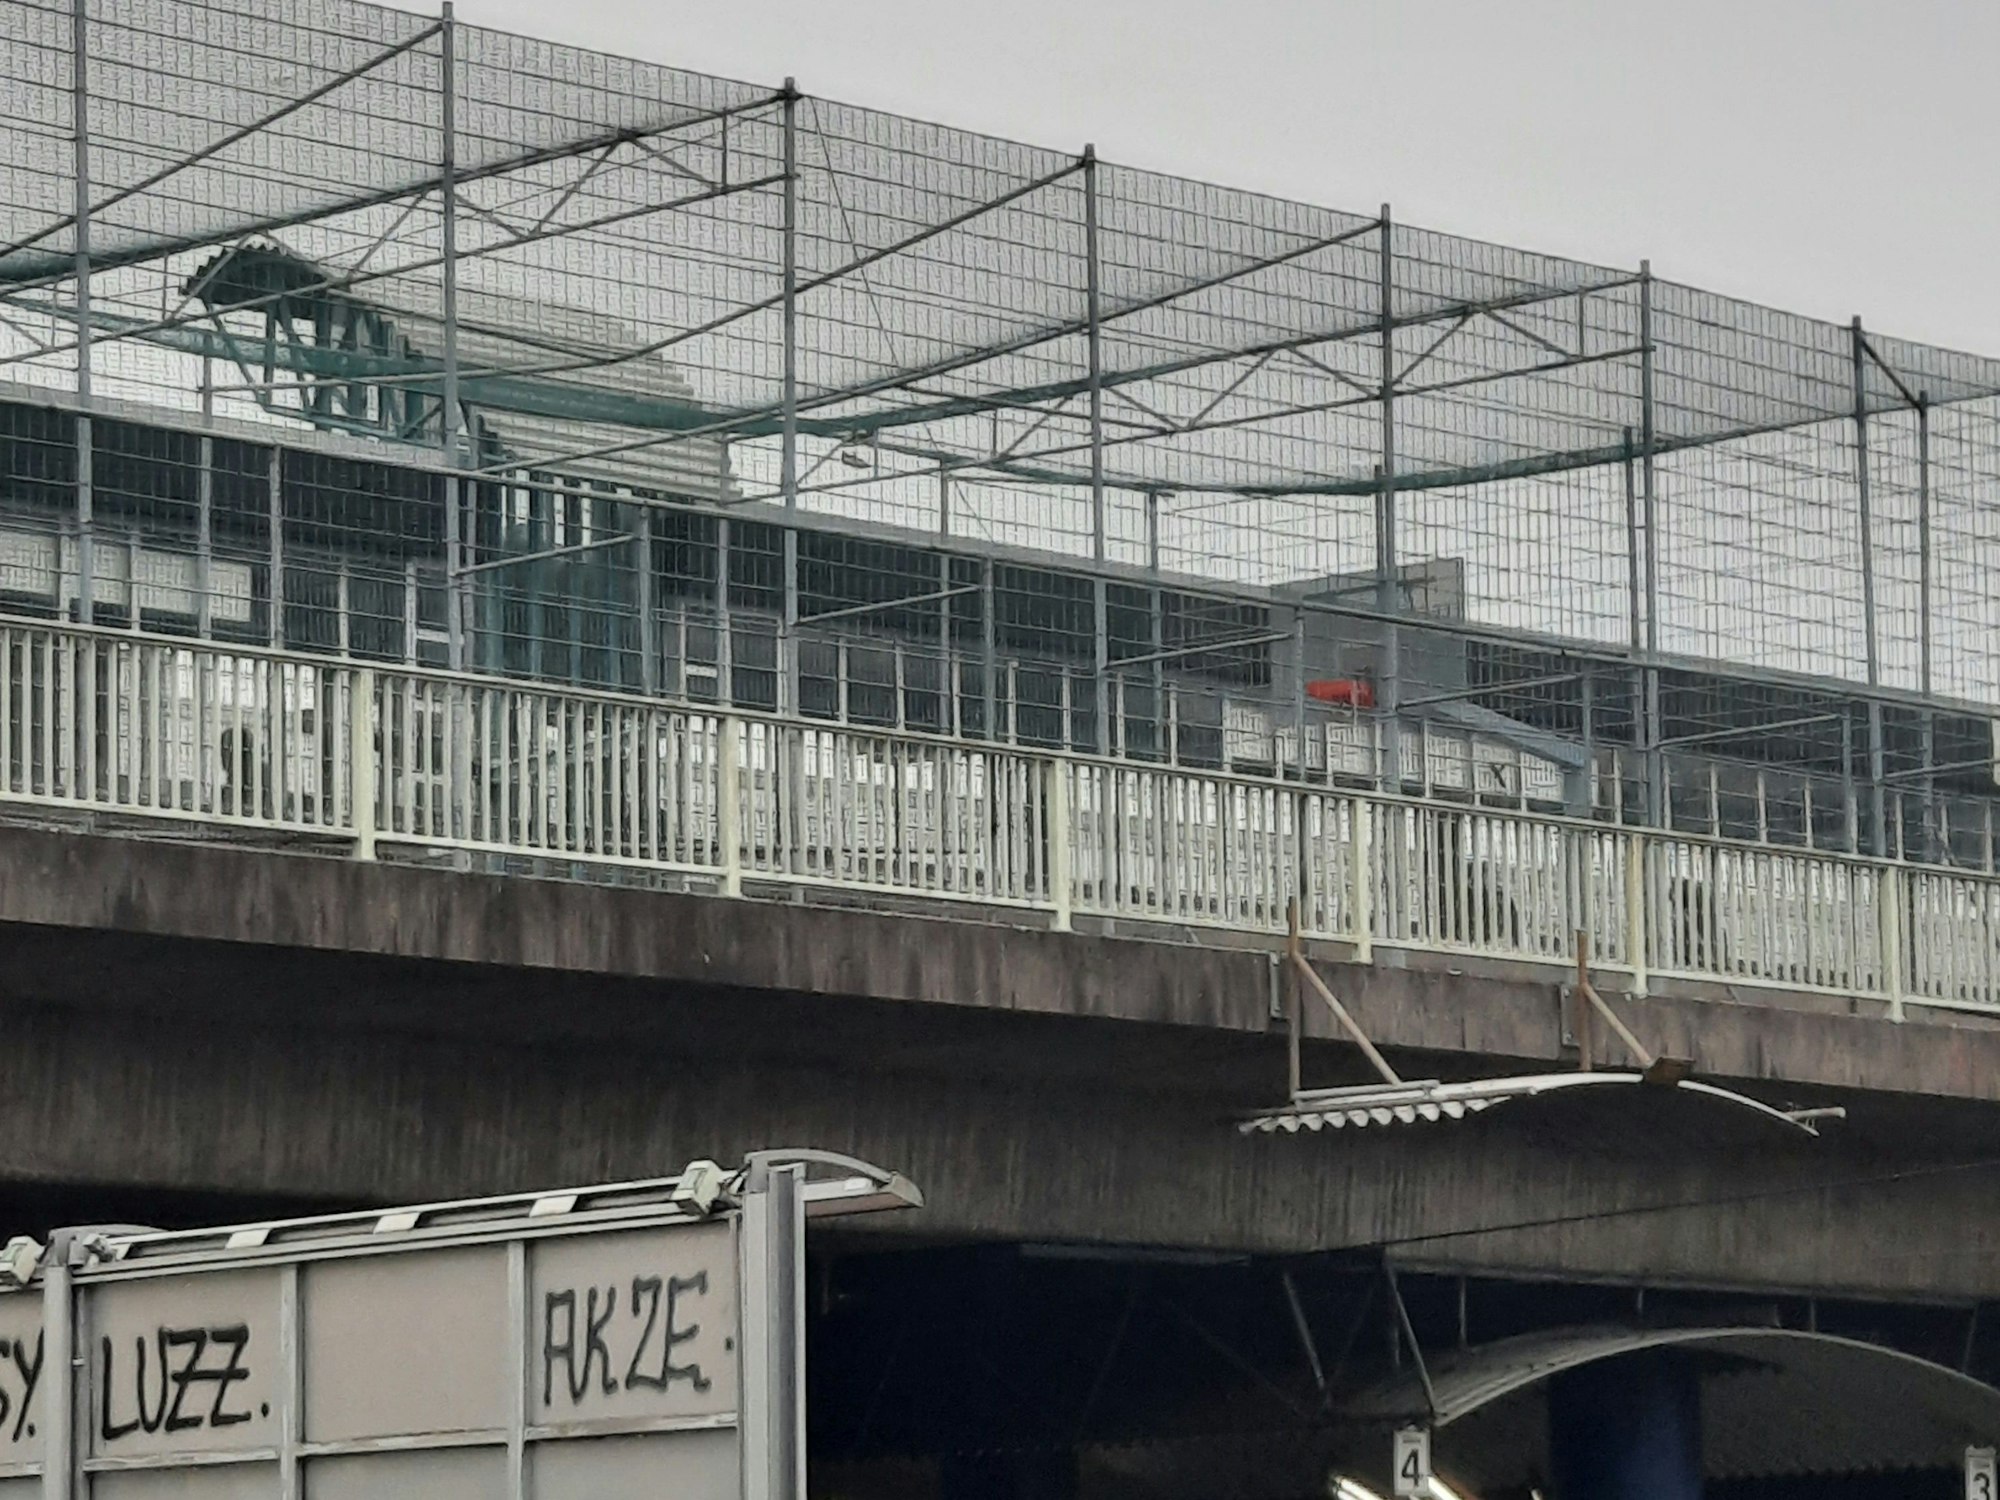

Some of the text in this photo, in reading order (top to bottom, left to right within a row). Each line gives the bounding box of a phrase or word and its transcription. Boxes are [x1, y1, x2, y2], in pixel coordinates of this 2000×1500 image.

[102, 1323, 270, 1441] LUZZ.
[1402, 1448, 1422, 1488] 4
[1973, 1472, 1990, 1500] 3
